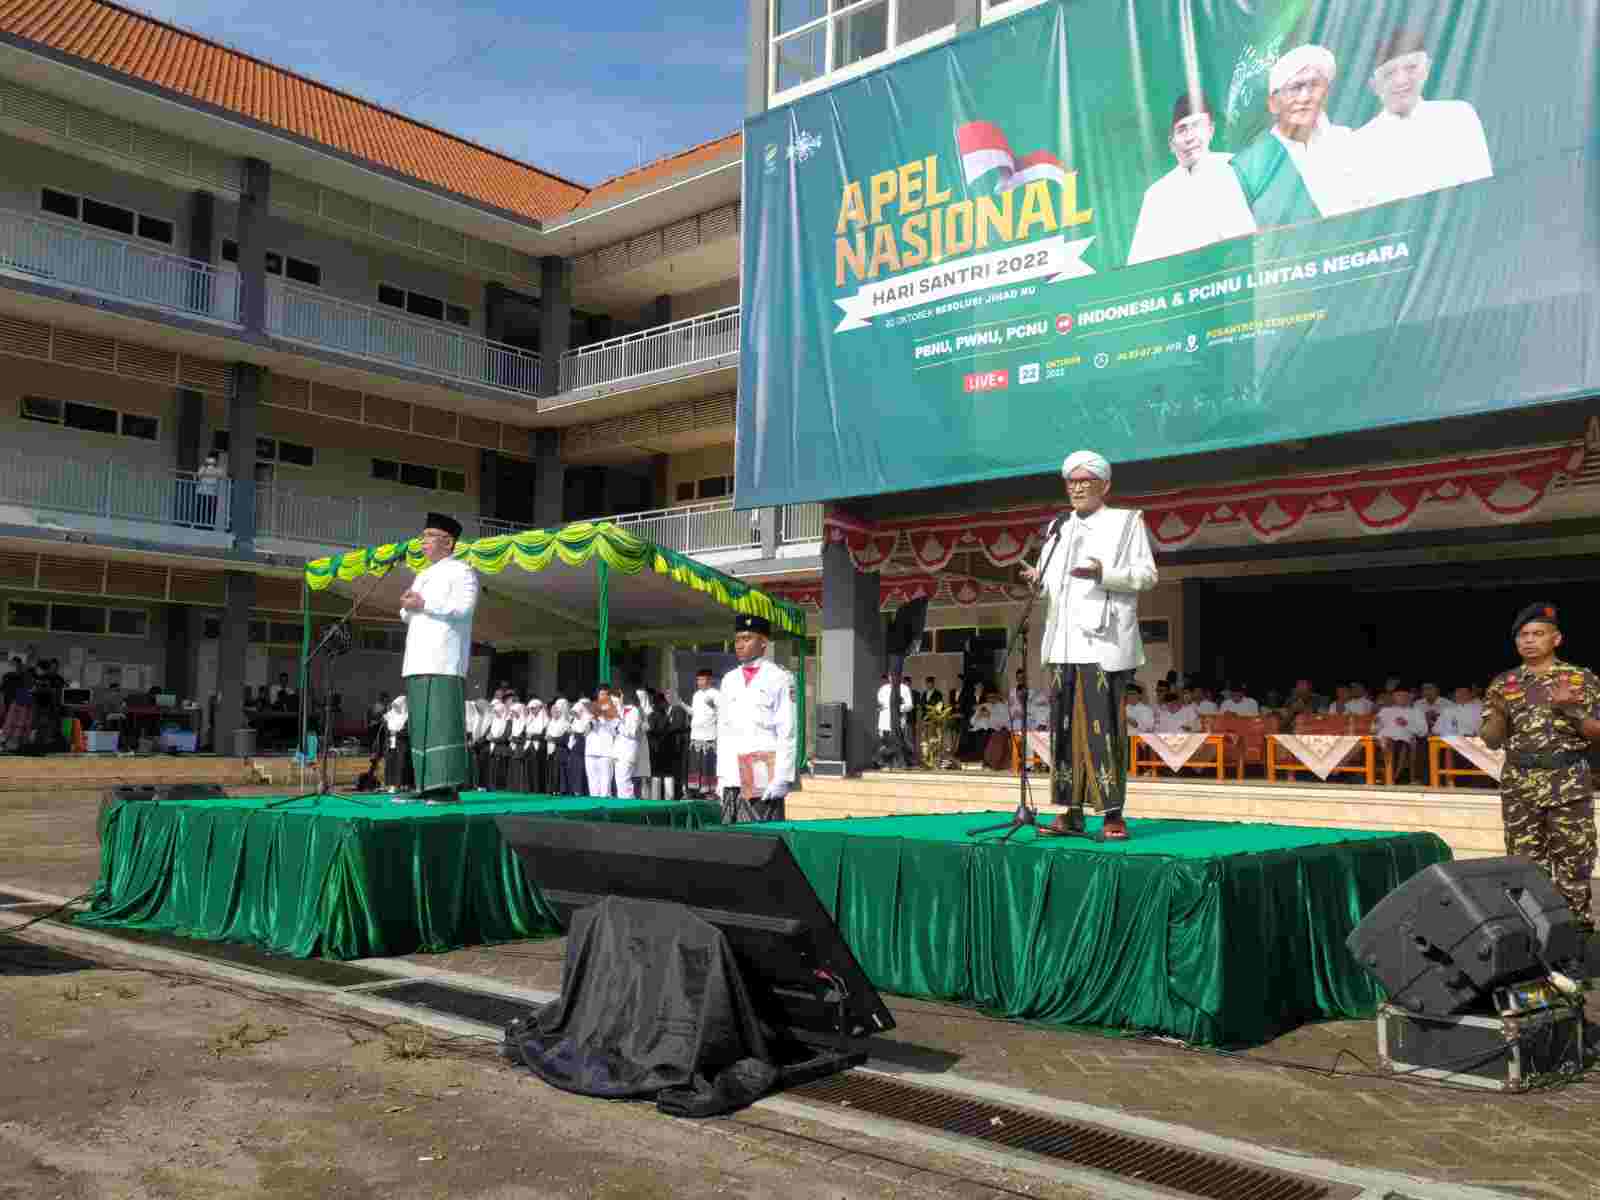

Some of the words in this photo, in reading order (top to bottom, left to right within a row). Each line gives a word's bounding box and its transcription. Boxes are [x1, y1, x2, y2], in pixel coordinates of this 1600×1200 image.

[835, 154, 952, 236] APEL
[835, 169, 1095, 288] NASIONAL
[872, 282, 914, 307] HARI
[919, 263, 990, 294] SANTRI
[996, 250, 1049, 276] 2022
[1077, 297, 1168, 326] INDONESIA
[1172, 293, 1184, 308] &
[1189, 276, 1242, 303] PCINU
[1246, 261, 1317, 289] LINTAS
[1323, 242, 1410, 275] NEGARA
[915, 339, 953, 359] PBNU,
[956, 330, 1003, 350] PWNU,
[1006, 320, 1049, 342] PCNU
[967, 373, 998, 391] LIVE
